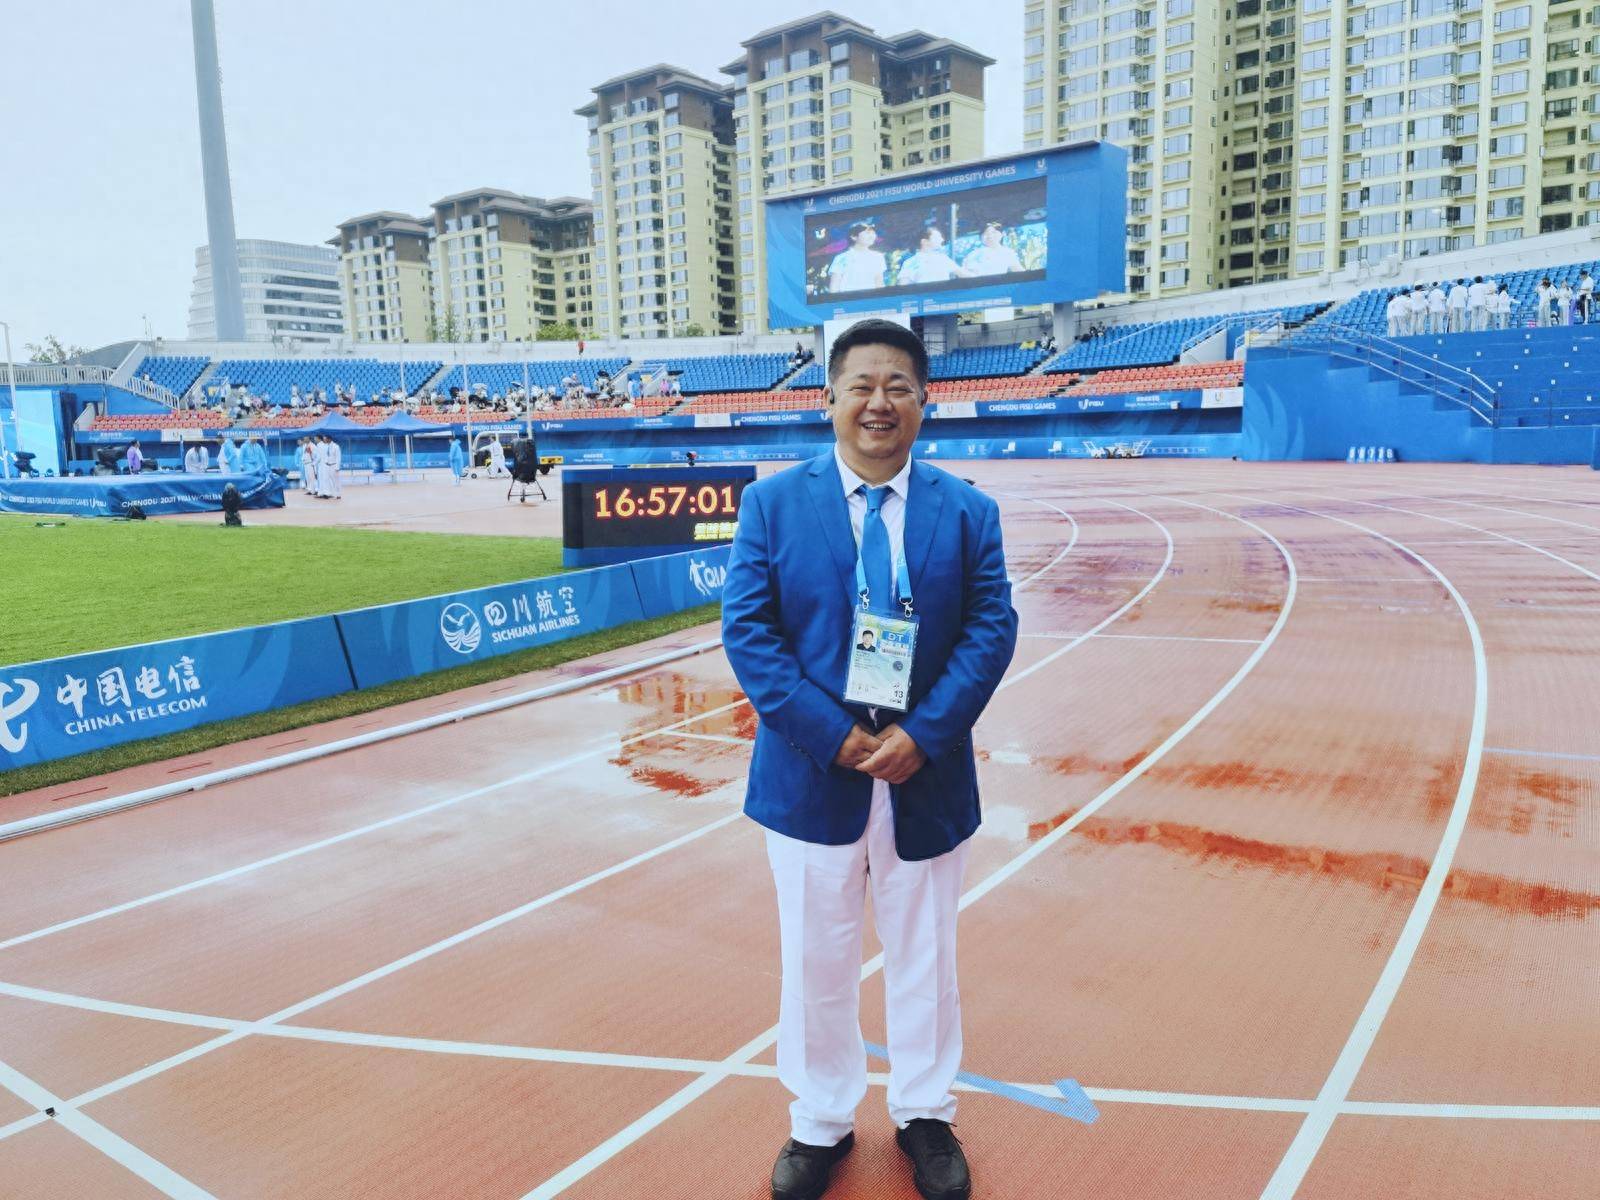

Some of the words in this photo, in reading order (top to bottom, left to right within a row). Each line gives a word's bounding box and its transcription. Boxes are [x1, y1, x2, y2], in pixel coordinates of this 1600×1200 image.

[829, 192, 865, 206] CHENGDU
[866, 189, 883, 199] 2021
[885, 186, 901, 197] FISU
[902, 181, 933, 193] WORLD
[935, 171, 984, 188] UNIVERSITY
[985, 166, 1016, 179] GAMES
[741, 415, 767, 423] CHENGDU
[989, 404, 1018, 412] CHENGDU
[1034, 402, 1057, 410] GAMES
[121, 498, 158, 508] CHENGDU
[595, 485, 736, 518] 16:57:01
[484, 586, 576, 627] 四川航空
[491, 623, 537, 643] SICHUAN
[539, 614, 581, 633] AIRLINES
[57, 655, 202, 718] 中国电信
[65, 711, 124, 735] CHINA
[129, 695, 208, 722] TELECOM
